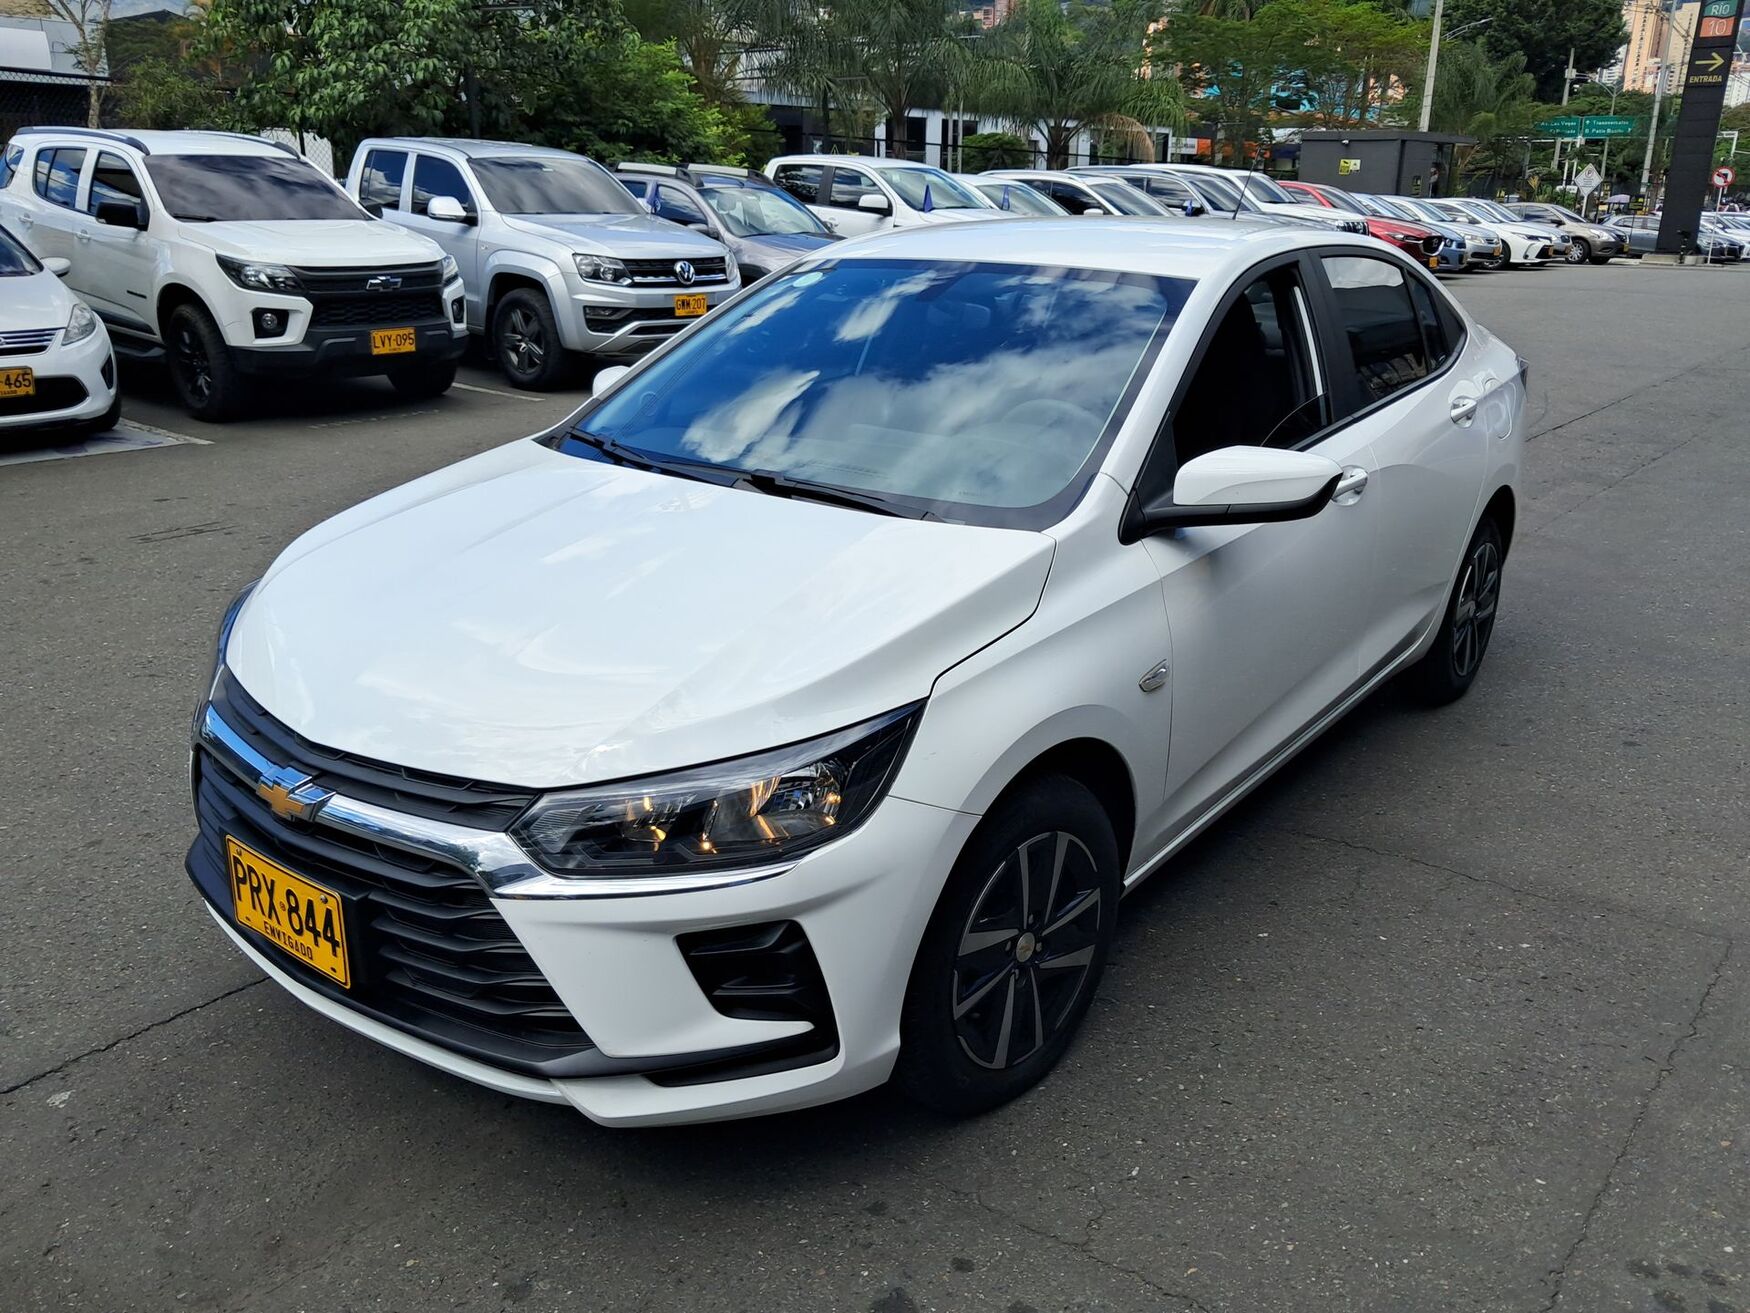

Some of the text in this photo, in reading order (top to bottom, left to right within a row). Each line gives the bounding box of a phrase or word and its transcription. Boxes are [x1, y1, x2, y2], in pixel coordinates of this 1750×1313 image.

[1709, 19, 1727, 35] 10
[1689, 75, 1723, 83] ENTRADA
[263, 921, 314, 961] ENVIGADO
